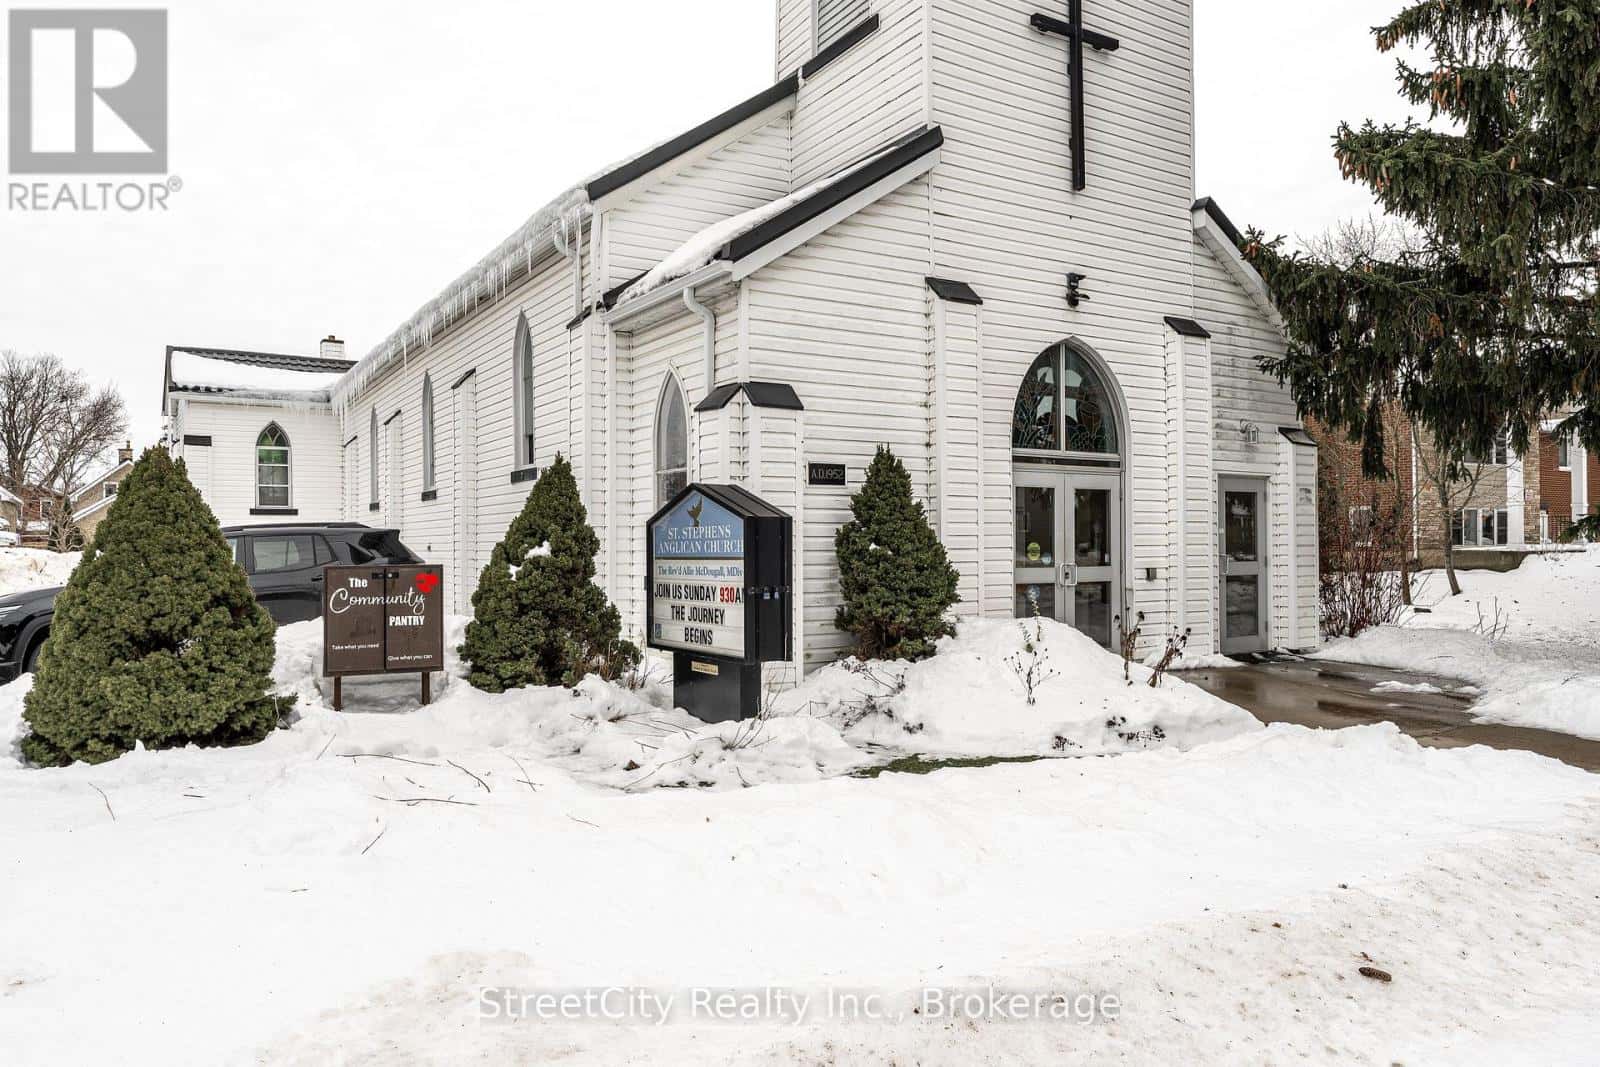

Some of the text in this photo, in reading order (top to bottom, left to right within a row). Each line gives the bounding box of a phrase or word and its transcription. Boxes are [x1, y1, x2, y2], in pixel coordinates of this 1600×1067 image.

[668, 524, 731, 540] ST. STEPHENS
[659, 539, 744, 553] ANGLICAN CHURCH
[348, 577, 368, 588] The
[329, 586, 426, 615] Community
[655, 584, 671, 598] JOIN
[672, 584, 682, 600] US
[683, 585, 716, 602] SUNDAY
[389, 615, 425, 627] PANTRY
[671, 606, 725, 625] THE JOURNEY
[684, 627, 713, 645] BEGINS
